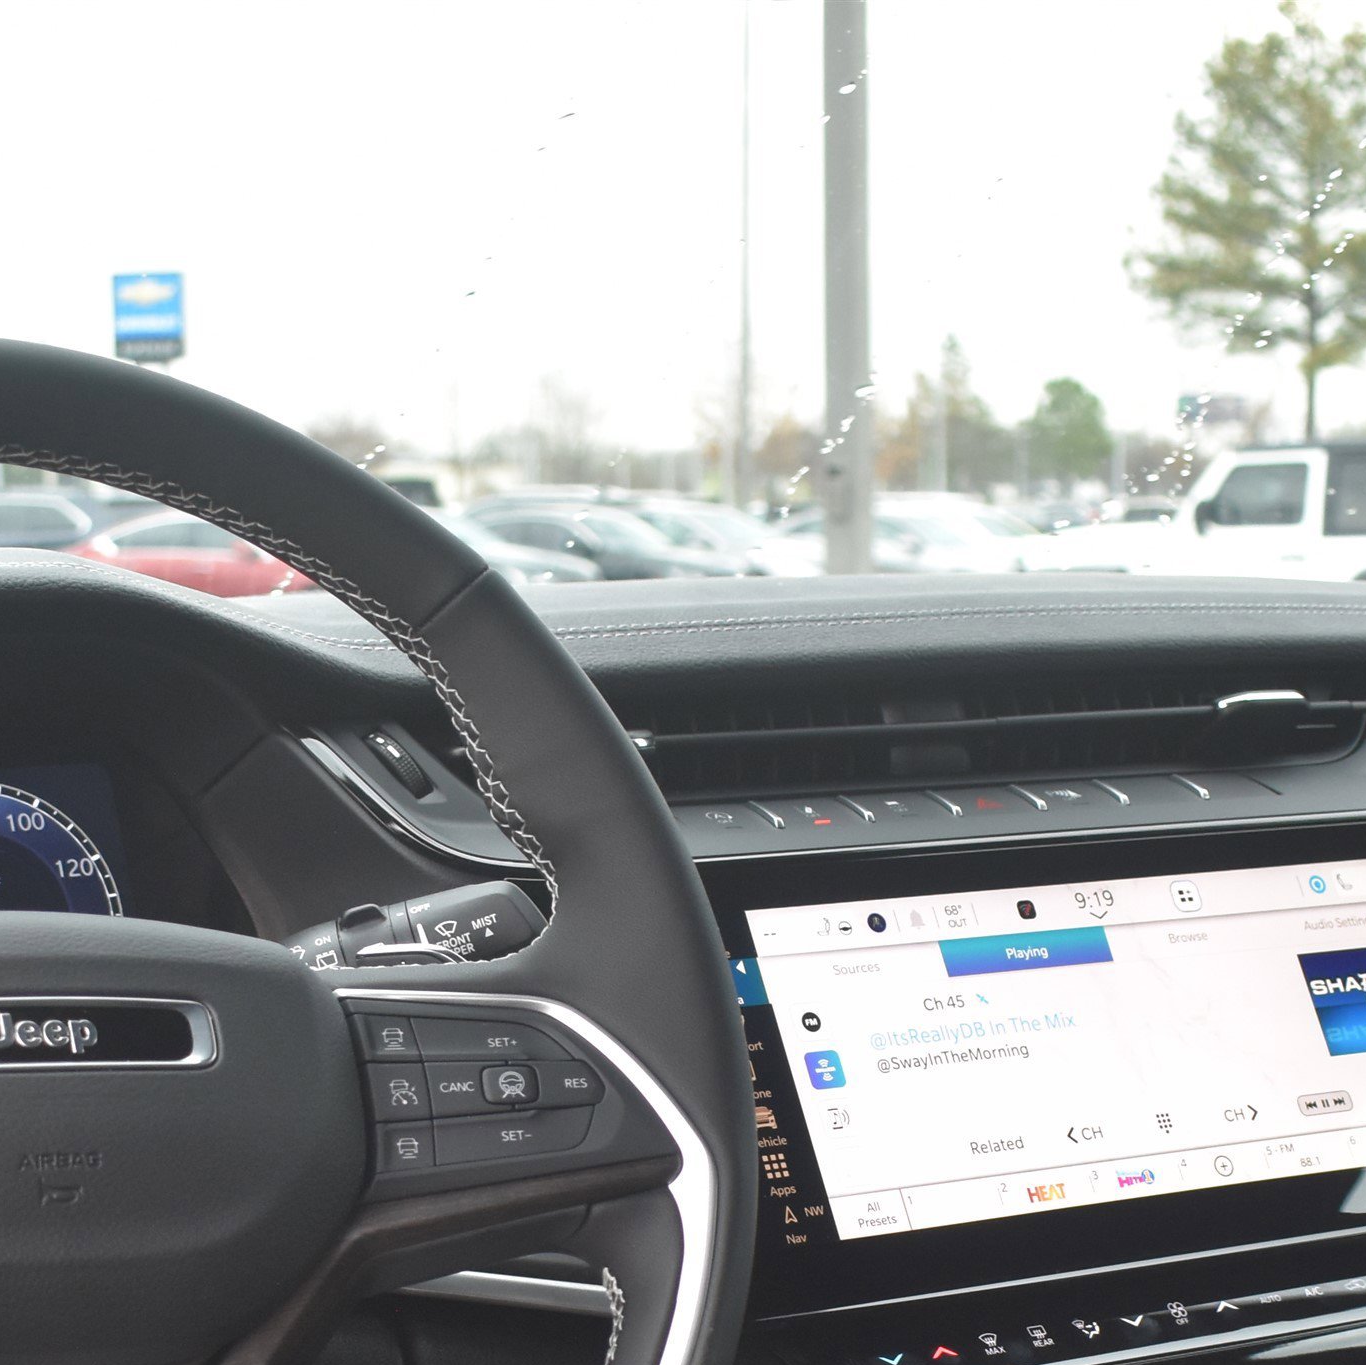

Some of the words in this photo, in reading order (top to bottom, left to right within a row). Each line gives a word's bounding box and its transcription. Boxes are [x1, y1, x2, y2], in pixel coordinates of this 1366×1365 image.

[6, 812, 45, 832] 100
[55, 858, 94, 879] 120
[1074, 890, 1115, 910] 9:19
[471, 913, 497, 931] MIST
[949, 918, 967, 928] OUT
[1304, 918, 1333, 931] Audio
[315, 935, 332, 946] ON
[1169, 931, 1209, 944] Browse
[1005, 946, 1049, 960] Playing
[833, 962, 881, 976] Sources
[923, 997, 944, 1011] Ch
[947, 995, 965, 1008] 45
[870, 1021, 986, 1050] @ItsReallyDB
[989, 1020, 1006, 1036] In
[1008, 1016, 1041, 1032] The
[1044, 1012, 1076, 1029] Mix
[488, 1036, 517, 1048] SET+
[877, 1043, 1030, 1073] @SwayInTheMorning
[439, 1081, 475, 1093] CANC
[564, 1077, 588, 1089] RES
[1224, 1108, 1246, 1122] CH
[501, 1130, 532, 1142] SET-
[1082, 1126, 1104, 1141] CH
[758, 1135, 787, 1147] ehicle
[970, 1137, 1024, 1155] Related
[20, 1153, 103, 1172] AIRBAG
[1300, 1156, 1321, 1168] 88.1
[1092, 1170, 1099, 1180] 3
[770, 1184, 797, 1198] Apps
[1001, 1183, 1008, 1192] 2
[1027, 1183, 1065, 1203] HEAT
[804, 1205, 824, 1217] NW
[867, 1202, 881, 1212] All
[858, 1214, 897, 1228] Presets
[786, 1233, 807, 1244] Nav
[1304, 1286, 1324, 1298] A/C
[1259, 1294, 1282, 1304] AUTO
[1033, 1337, 1055, 1348] REAR
[984, 1345, 1006, 1356] MAX
